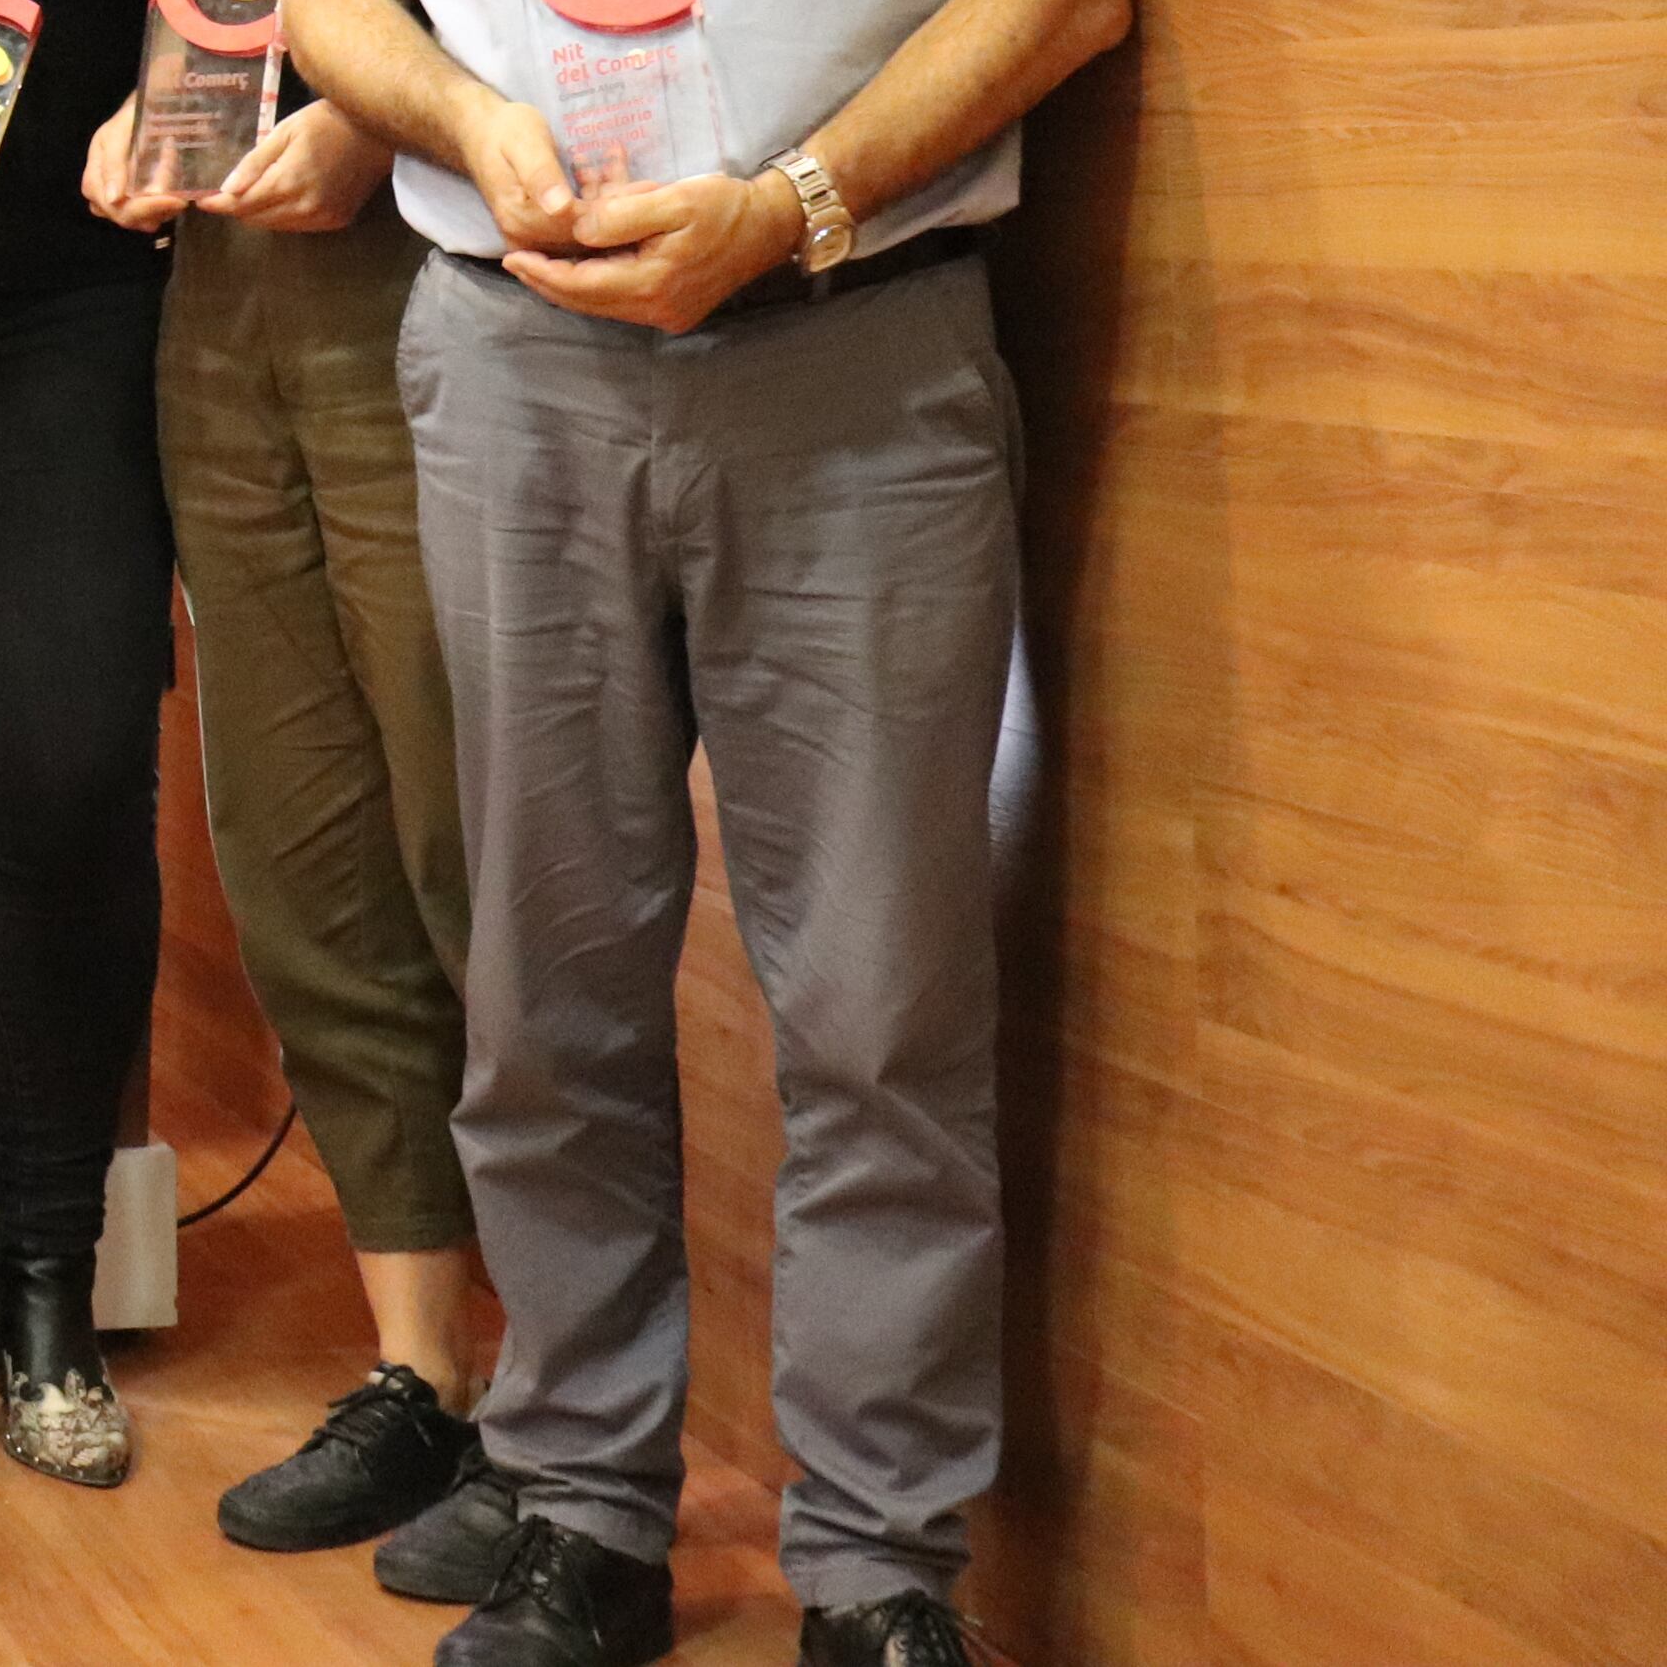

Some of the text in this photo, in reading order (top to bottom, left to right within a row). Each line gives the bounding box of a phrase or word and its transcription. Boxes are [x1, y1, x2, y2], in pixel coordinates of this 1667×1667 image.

[552, 43, 585, 65] Nit
[183, 72, 251, 91] Comerç
[556, 63, 591, 85] del
